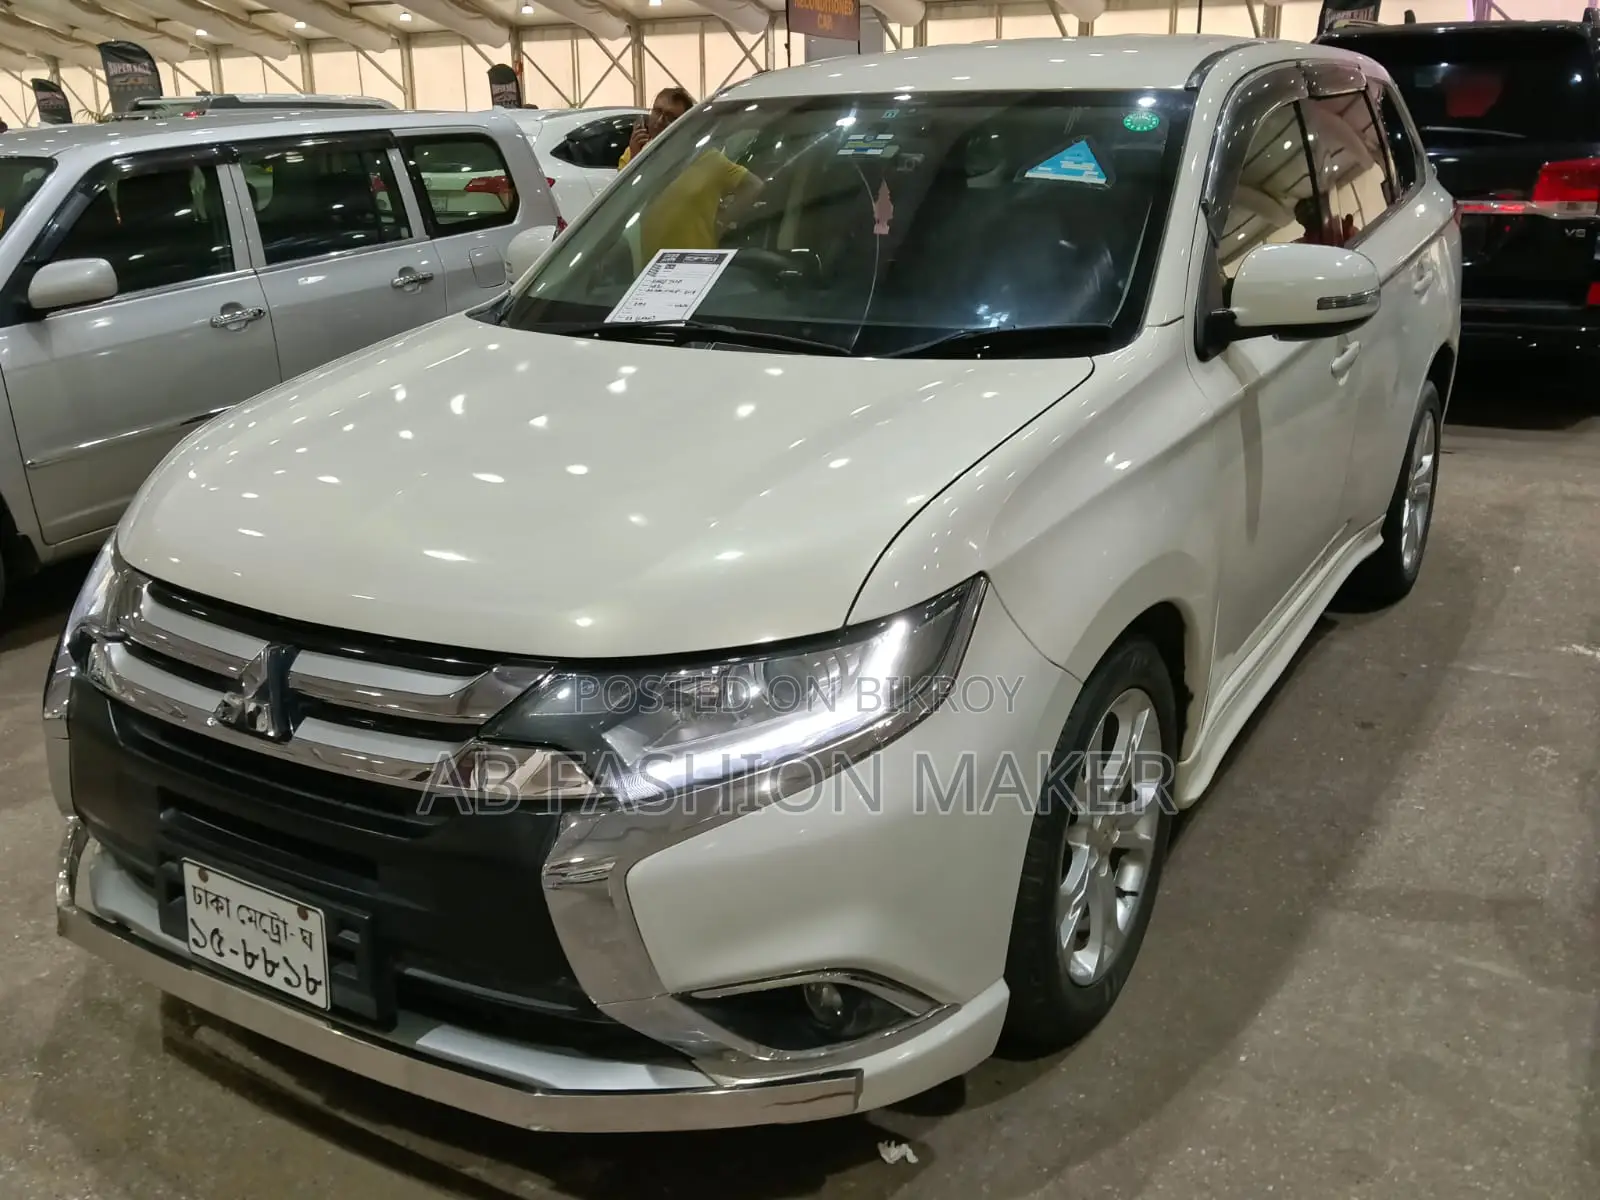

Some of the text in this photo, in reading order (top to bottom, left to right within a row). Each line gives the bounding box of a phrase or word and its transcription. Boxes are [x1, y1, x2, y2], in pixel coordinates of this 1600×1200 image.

[817, 13, 833, 31] CAR
[191, 884, 231, 919] ঢাকা
[189, 917, 322, 996] ১৫-৮৮১৮
